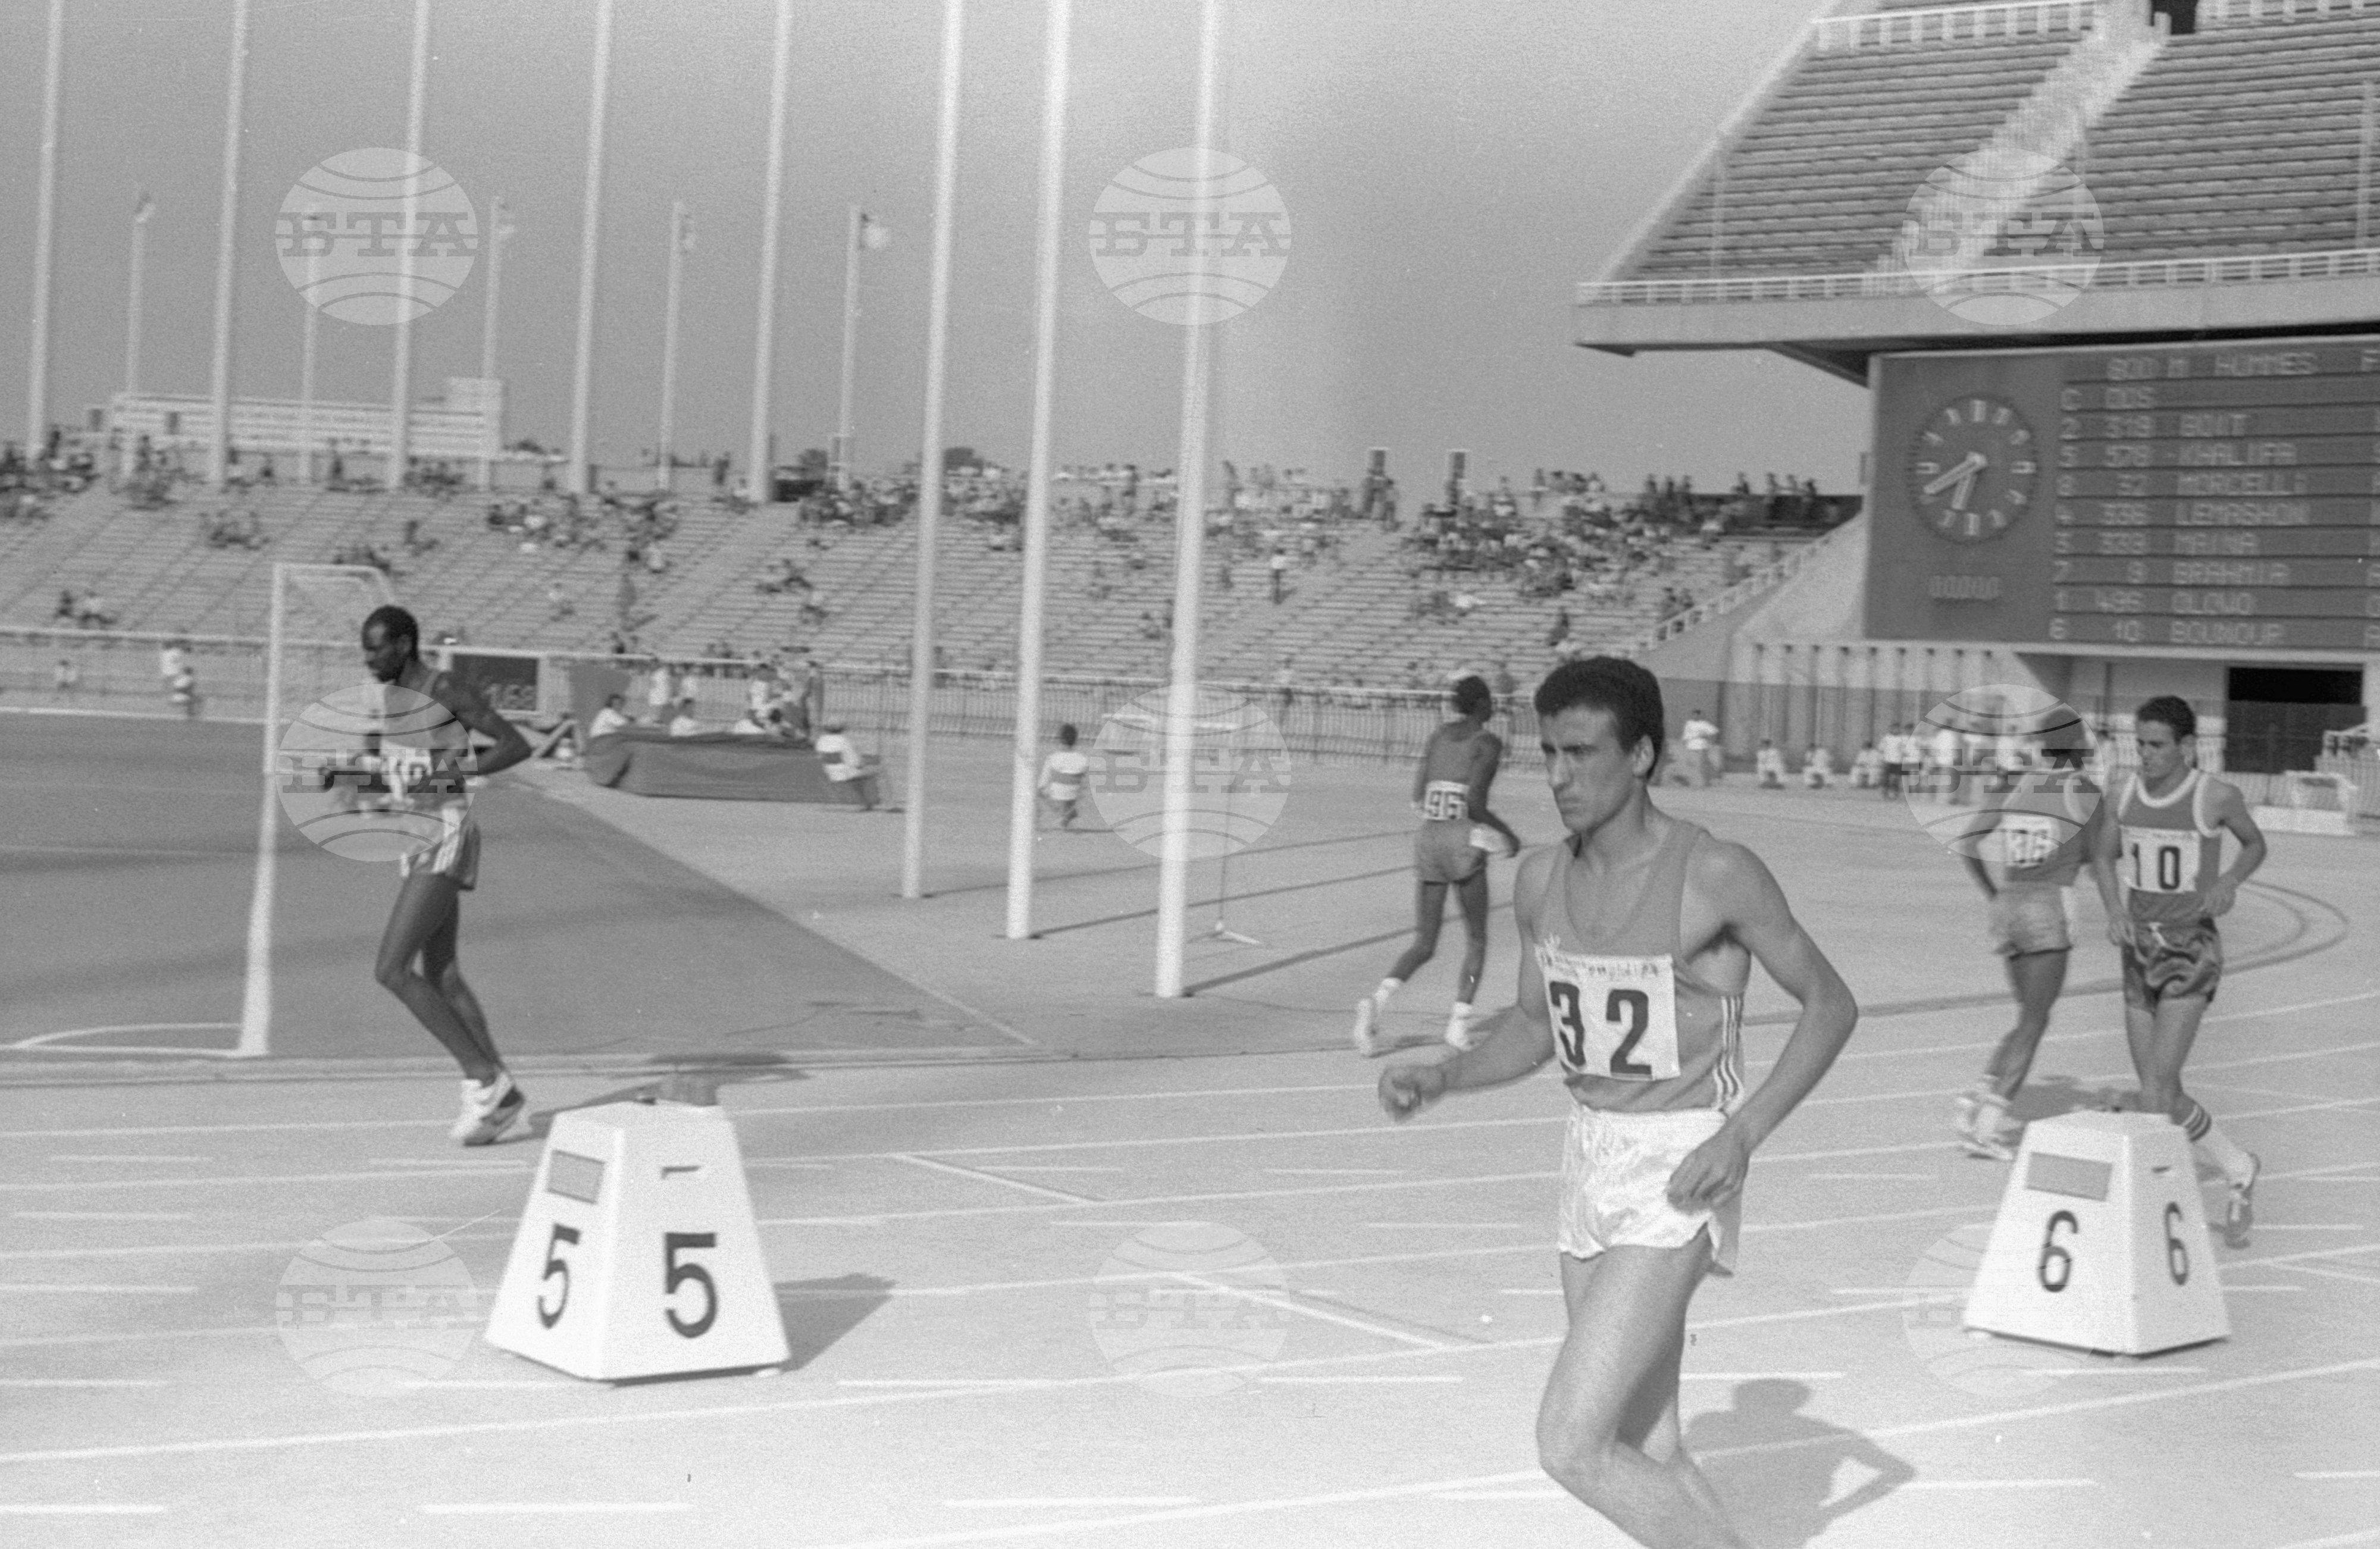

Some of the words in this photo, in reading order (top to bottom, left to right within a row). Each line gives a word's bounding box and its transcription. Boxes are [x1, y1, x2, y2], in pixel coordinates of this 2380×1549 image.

[2131, 844, 2181, 890] 10
[1549, 981, 1652, 1075] 32
[538, 1223, 581, 1329] 5
[665, 1232, 718, 1339] 5
[2038, 1210, 2078, 1293] 6
[2164, 1202, 2190, 1286] 6
